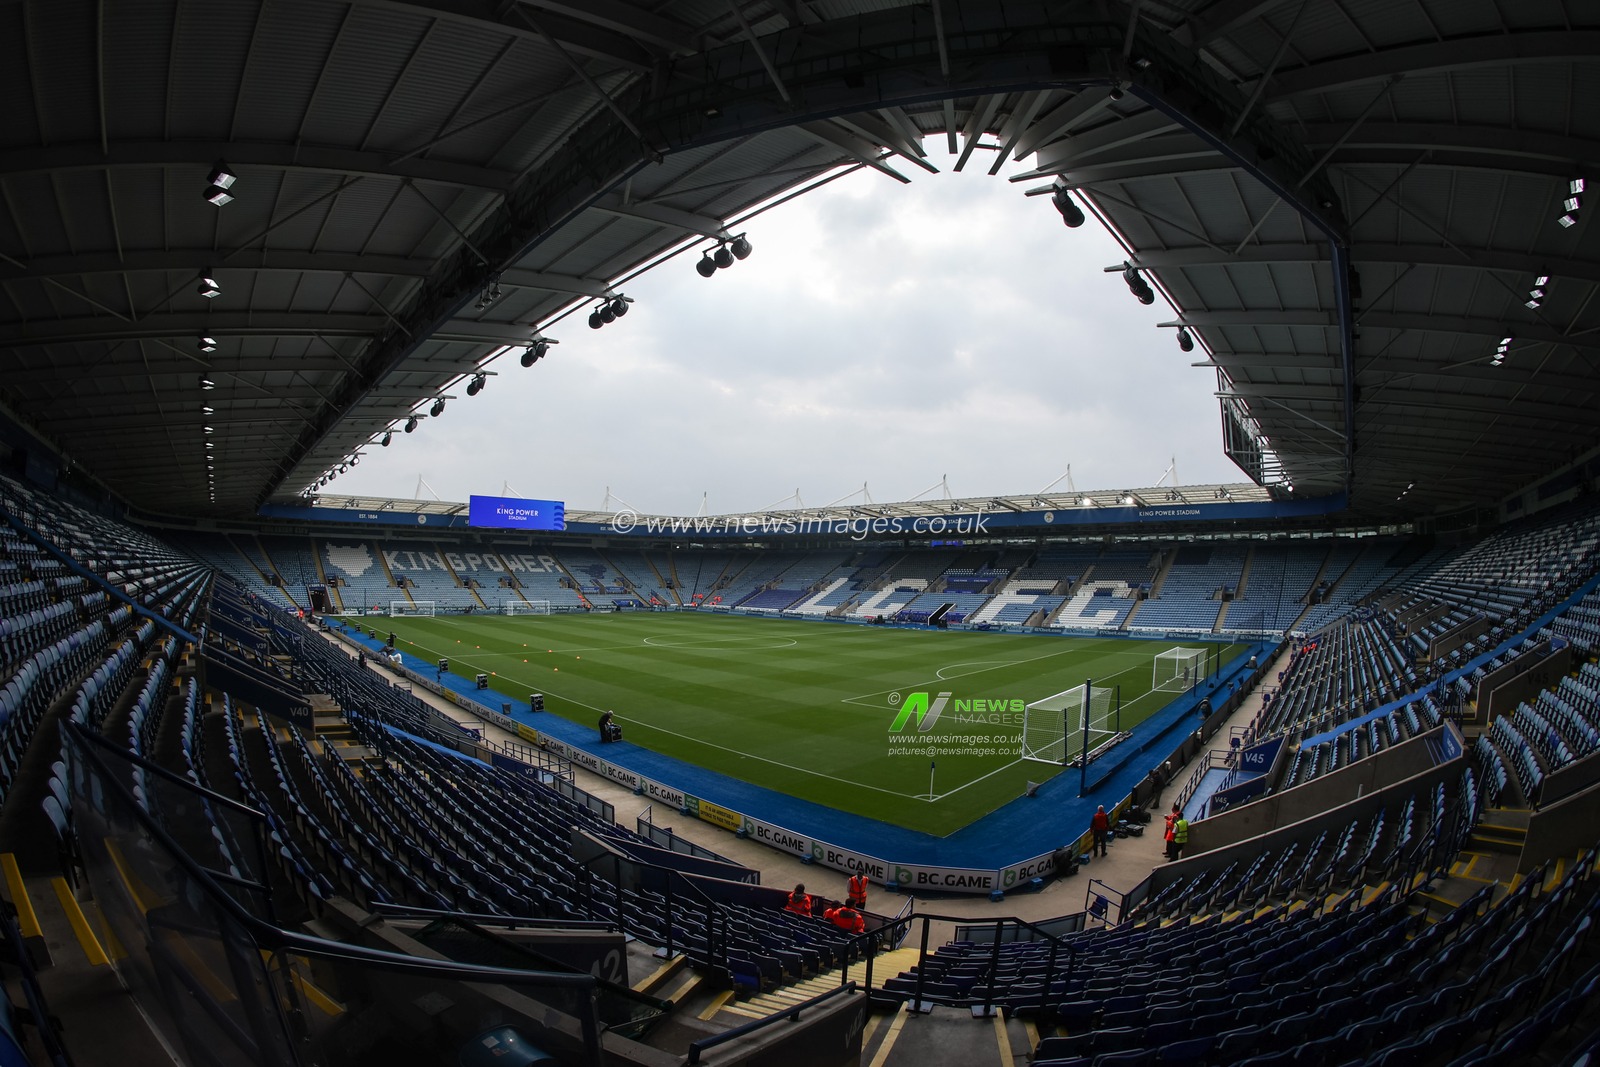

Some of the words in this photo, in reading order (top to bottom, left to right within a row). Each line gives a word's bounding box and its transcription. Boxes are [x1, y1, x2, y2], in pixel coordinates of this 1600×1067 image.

[515, 509, 539, 517] POWER
[290, 707, 309, 717] V40
[573, 751, 597, 769] BC.GAME
[1245, 752, 1265, 764] V45
[608, 766, 636, 786] BC.GAME
[650, 784, 683, 806] BC.GAME
[1214, 796, 1228, 804] V45
[757, 826, 804, 853] BC.GAME
[827, 850, 884, 879] BC.GAME
[1019, 856, 1057, 881] BC.GA
[917, 872, 992, 889] BC.GAME
